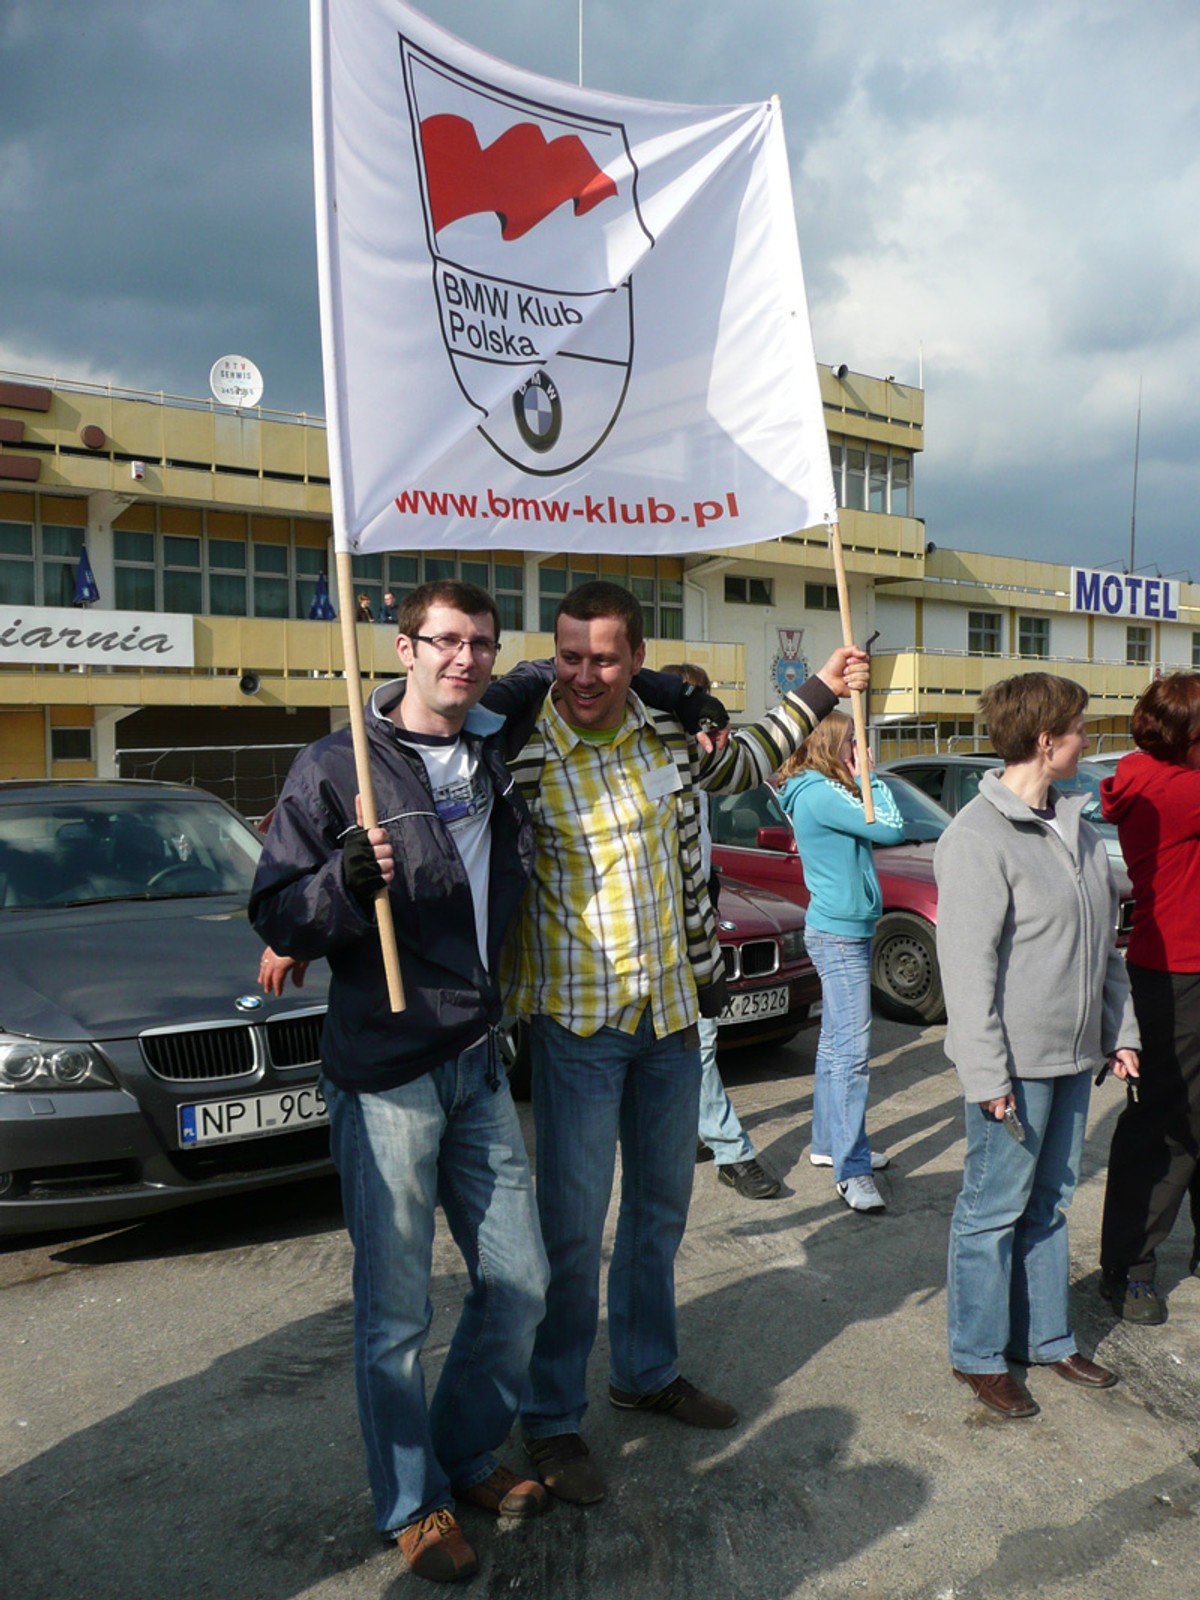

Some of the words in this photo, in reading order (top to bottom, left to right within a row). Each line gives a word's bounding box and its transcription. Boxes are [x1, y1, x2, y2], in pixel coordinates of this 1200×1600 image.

[443, 271, 508, 320] BMW
[517, 293, 583, 327] Klub
[449, 309, 540, 357] Polska
[395, 489, 739, 527] www.bmw-klub.pl
[1076, 570, 1177, 619] MOTEL
[741, 988, 786, 1016] 25326
